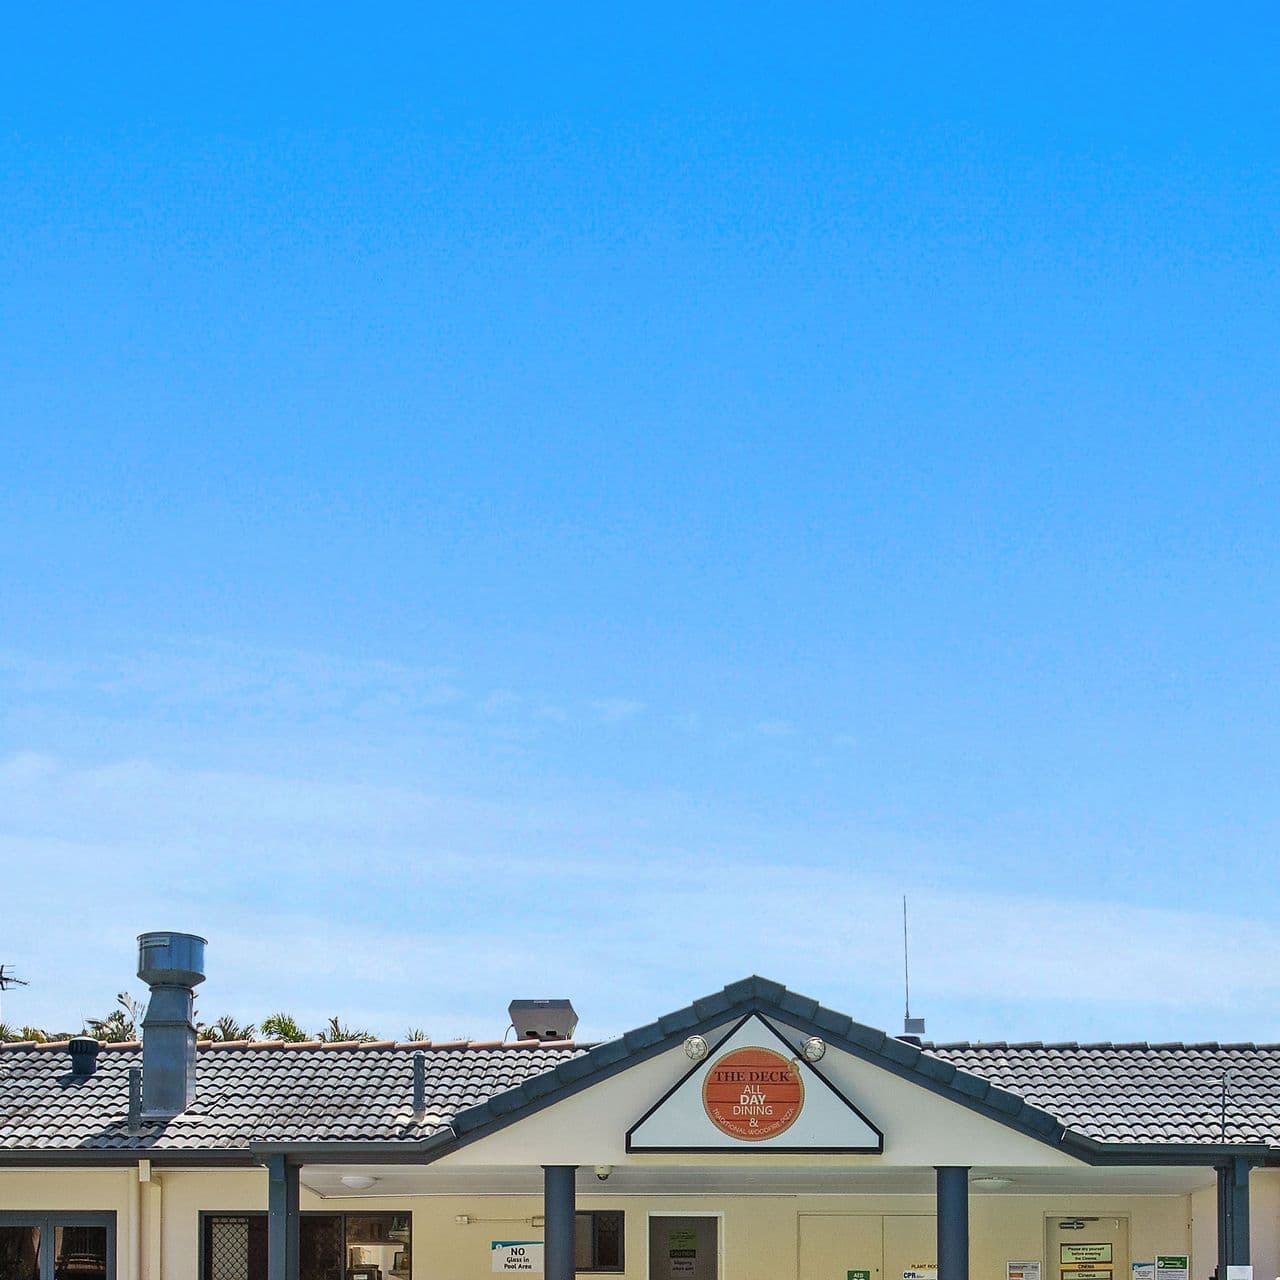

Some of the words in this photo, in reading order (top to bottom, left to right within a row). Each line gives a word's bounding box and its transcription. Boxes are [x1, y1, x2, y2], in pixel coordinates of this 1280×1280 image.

[715, 1071, 745, 1081] THE
[749, 1071, 790, 1081] DECK
[743, 1085, 763, 1094] ALL
[740, 1095, 766, 1105] DAY
[733, 1106, 773, 1115] DINING
[713, 1108, 747, 1135] TRADITIONAL
[749, 1118, 758, 1127] &
[511, 1247, 525, 1256] NO
